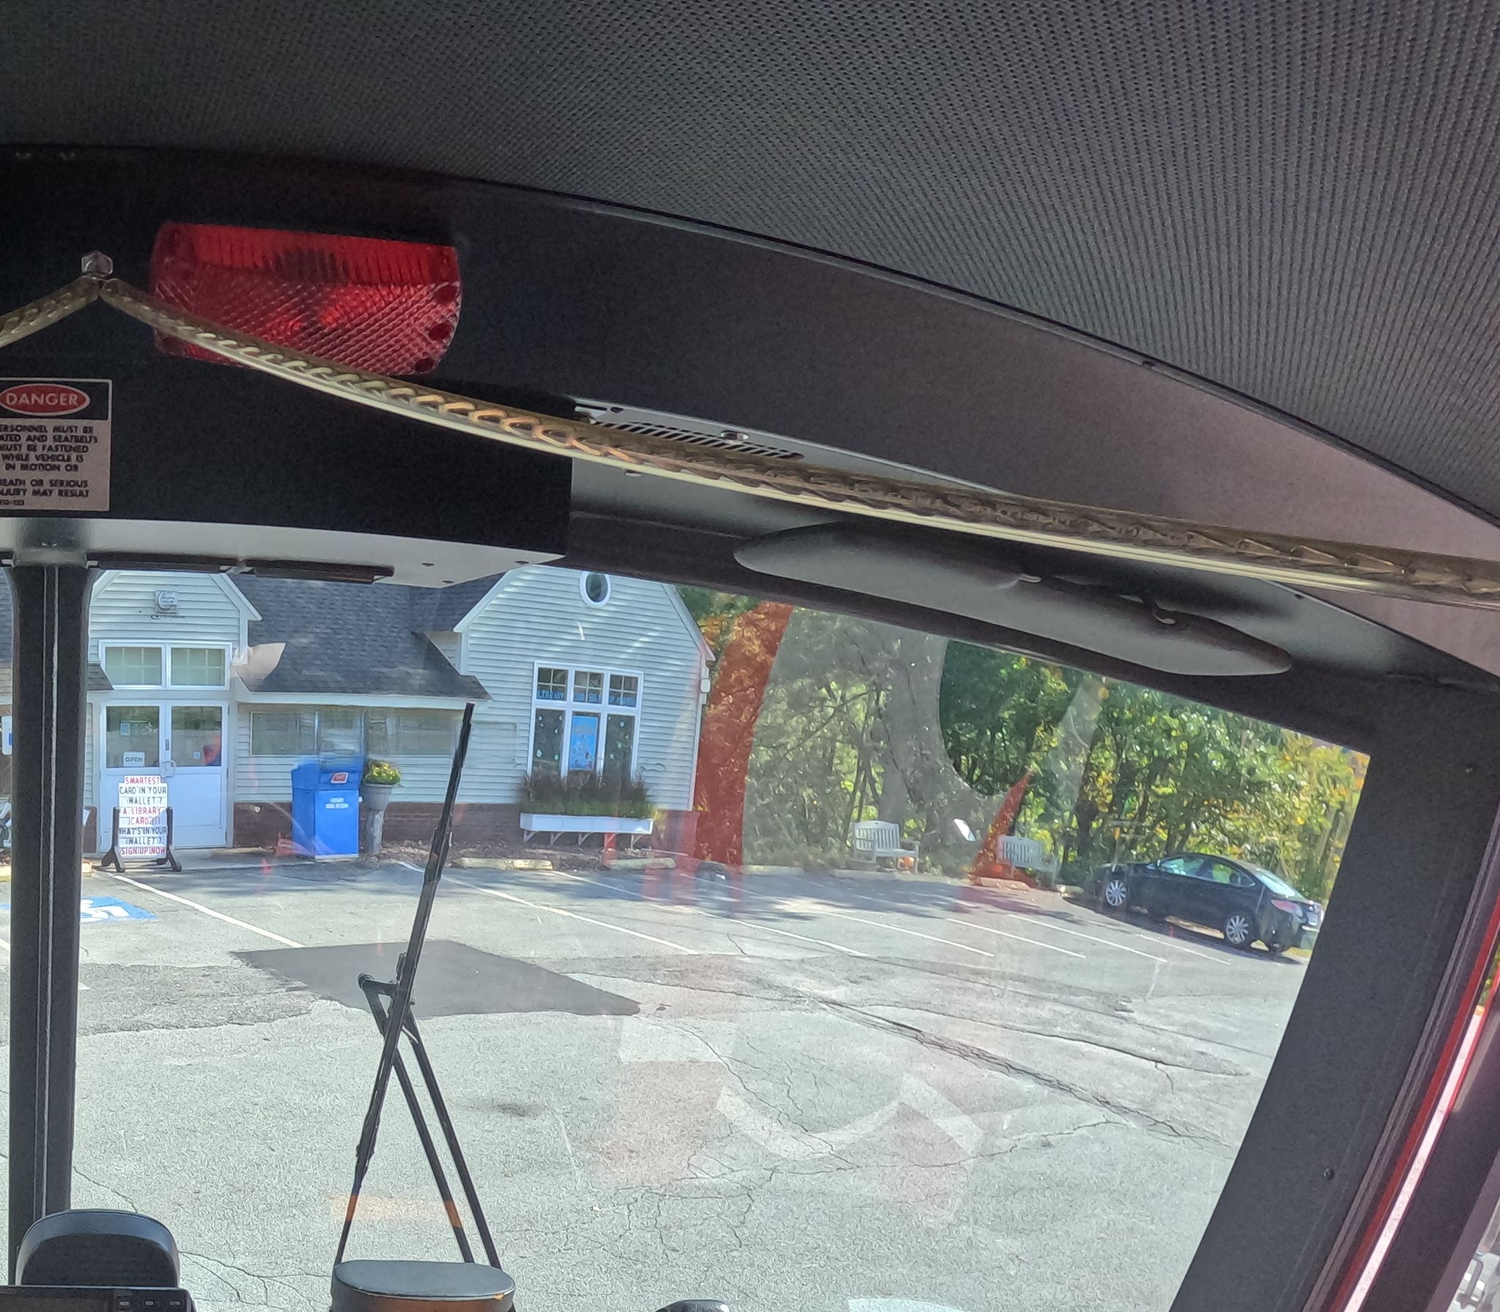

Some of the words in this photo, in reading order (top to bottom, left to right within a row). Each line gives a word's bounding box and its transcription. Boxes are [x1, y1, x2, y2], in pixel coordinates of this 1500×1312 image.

[5, 392, 78, 406] DANGER
[53, 424, 78, 433] MUST
[26, 434, 48, 443] AND
[52, 434, 98, 444] SEATBELTS
[42, 444, 90, 453] FASTENED
[1, 454, 30, 462] WHILE
[35, 454, 72, 463] VEHICLE
[76, 454, 85, 463] IS
[5, 463, 15, 471] IN
[20, 463, 61, 471] MOTION
[65, 463, 79, 472] OR
[30, 478, 44, 487] OR
[49, 479, 88, 488] SERIOUS
[32, 488, 53, 496] MAY
[58, 488, 90, 497] RESULT
[125, 776, 160, 785] SMARTEST
[119, 786, 136, 795] CARD
[122, 807, 128, 815] A
[131, 807, 161, 815] LIBRARY
[152, 827, 167, 835] YOUR
[121, 847, 138, 855] SIGN
[140, 847, 148, 855] UP
